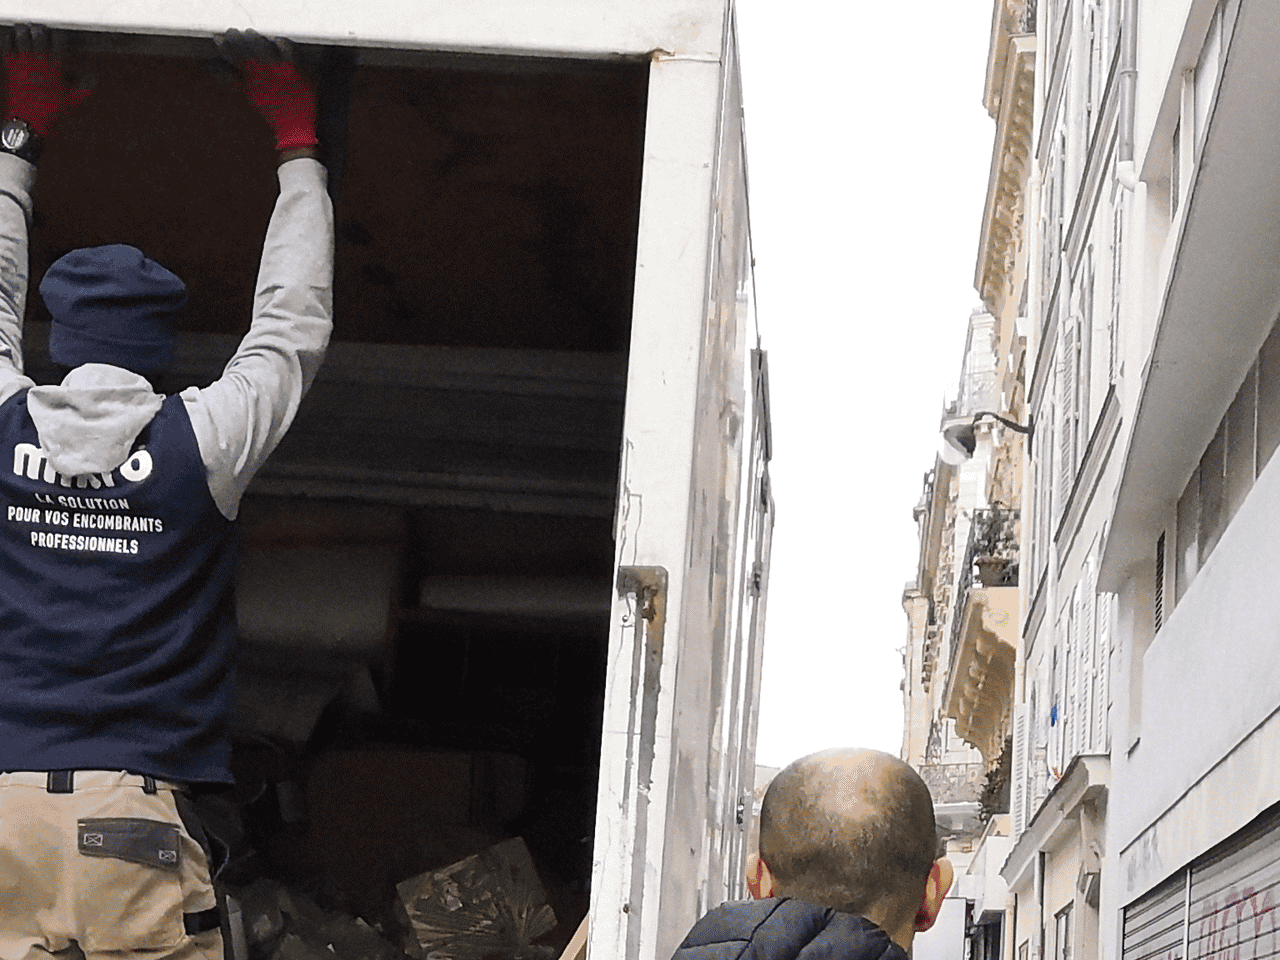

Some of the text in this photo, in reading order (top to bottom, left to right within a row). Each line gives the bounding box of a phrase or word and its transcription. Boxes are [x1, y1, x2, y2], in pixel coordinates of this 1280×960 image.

[34, 492, 130, 510] LA SOLUTION
[7, 505, 163, 532] POUR VOS ENCOMBRANTS
[30, 531, 139, 554] PROFESSIONNELS
